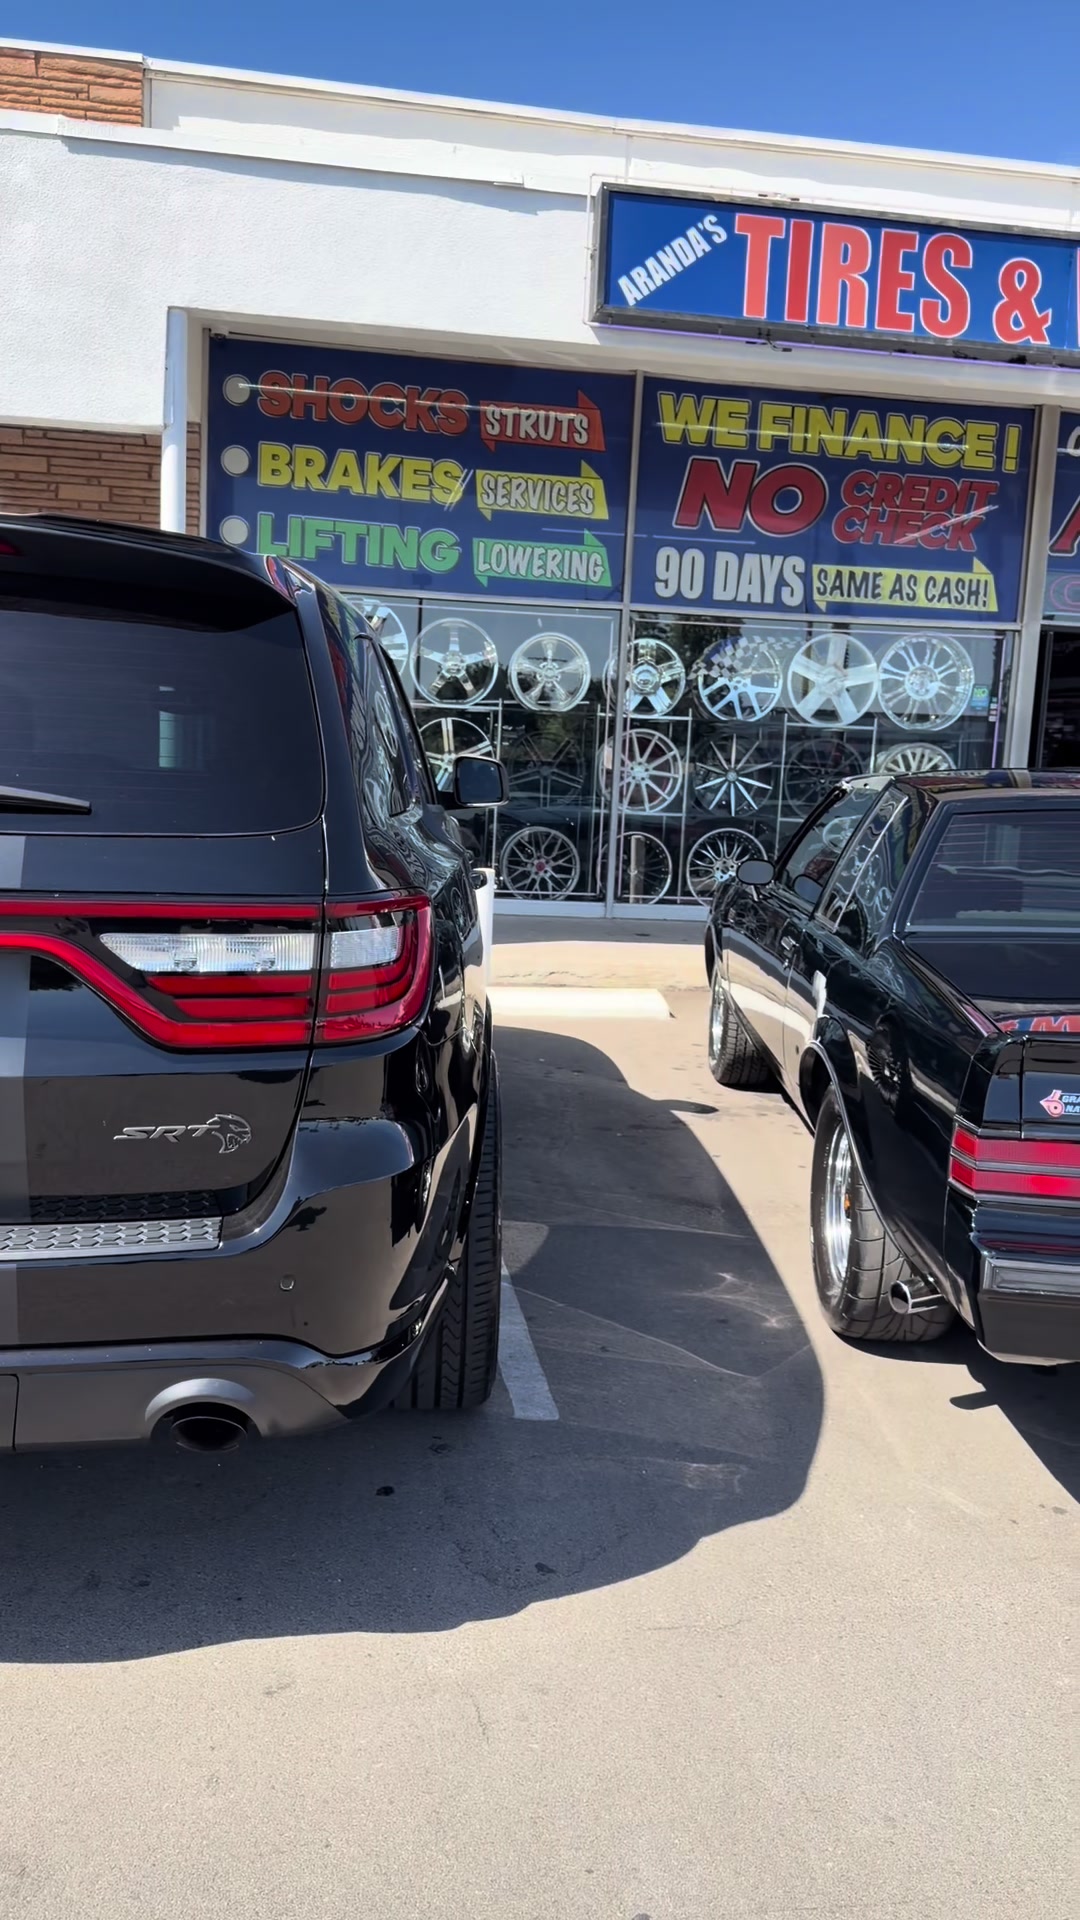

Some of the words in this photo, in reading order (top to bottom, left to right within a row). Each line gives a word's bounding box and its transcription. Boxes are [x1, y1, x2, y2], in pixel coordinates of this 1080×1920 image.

[617, 213, 728, 307] ARANDA'S
[735, 213, 973, 338] TIRES
[992, 257, 1053, 346] &
[257, 370, 470, 436] SHOCKS
[484, 403, 590, 446] STRUTS
[656, 392, 752, 448] WE
[256, 441, 467, 506] BRAKES
[481, 472, 595, 516] SERVICES
[672, 456, 829, 537] NO
[840, 469, 1000, 513] CREDIT
[256, 512, 463, 574] LIFTING
[831, 505, 987, 551] CHECK
[477, 541, 605, 584] LOWERING
[654, 546, 706, 601] 90
[712, 549, 806, 607] DAYS
[815, 567, 883, 601] SAME
[888, 572, 920, 602] AS
[923, 576, 990, 608] CASH!
[113, 1125, 220, 1142] SRT
